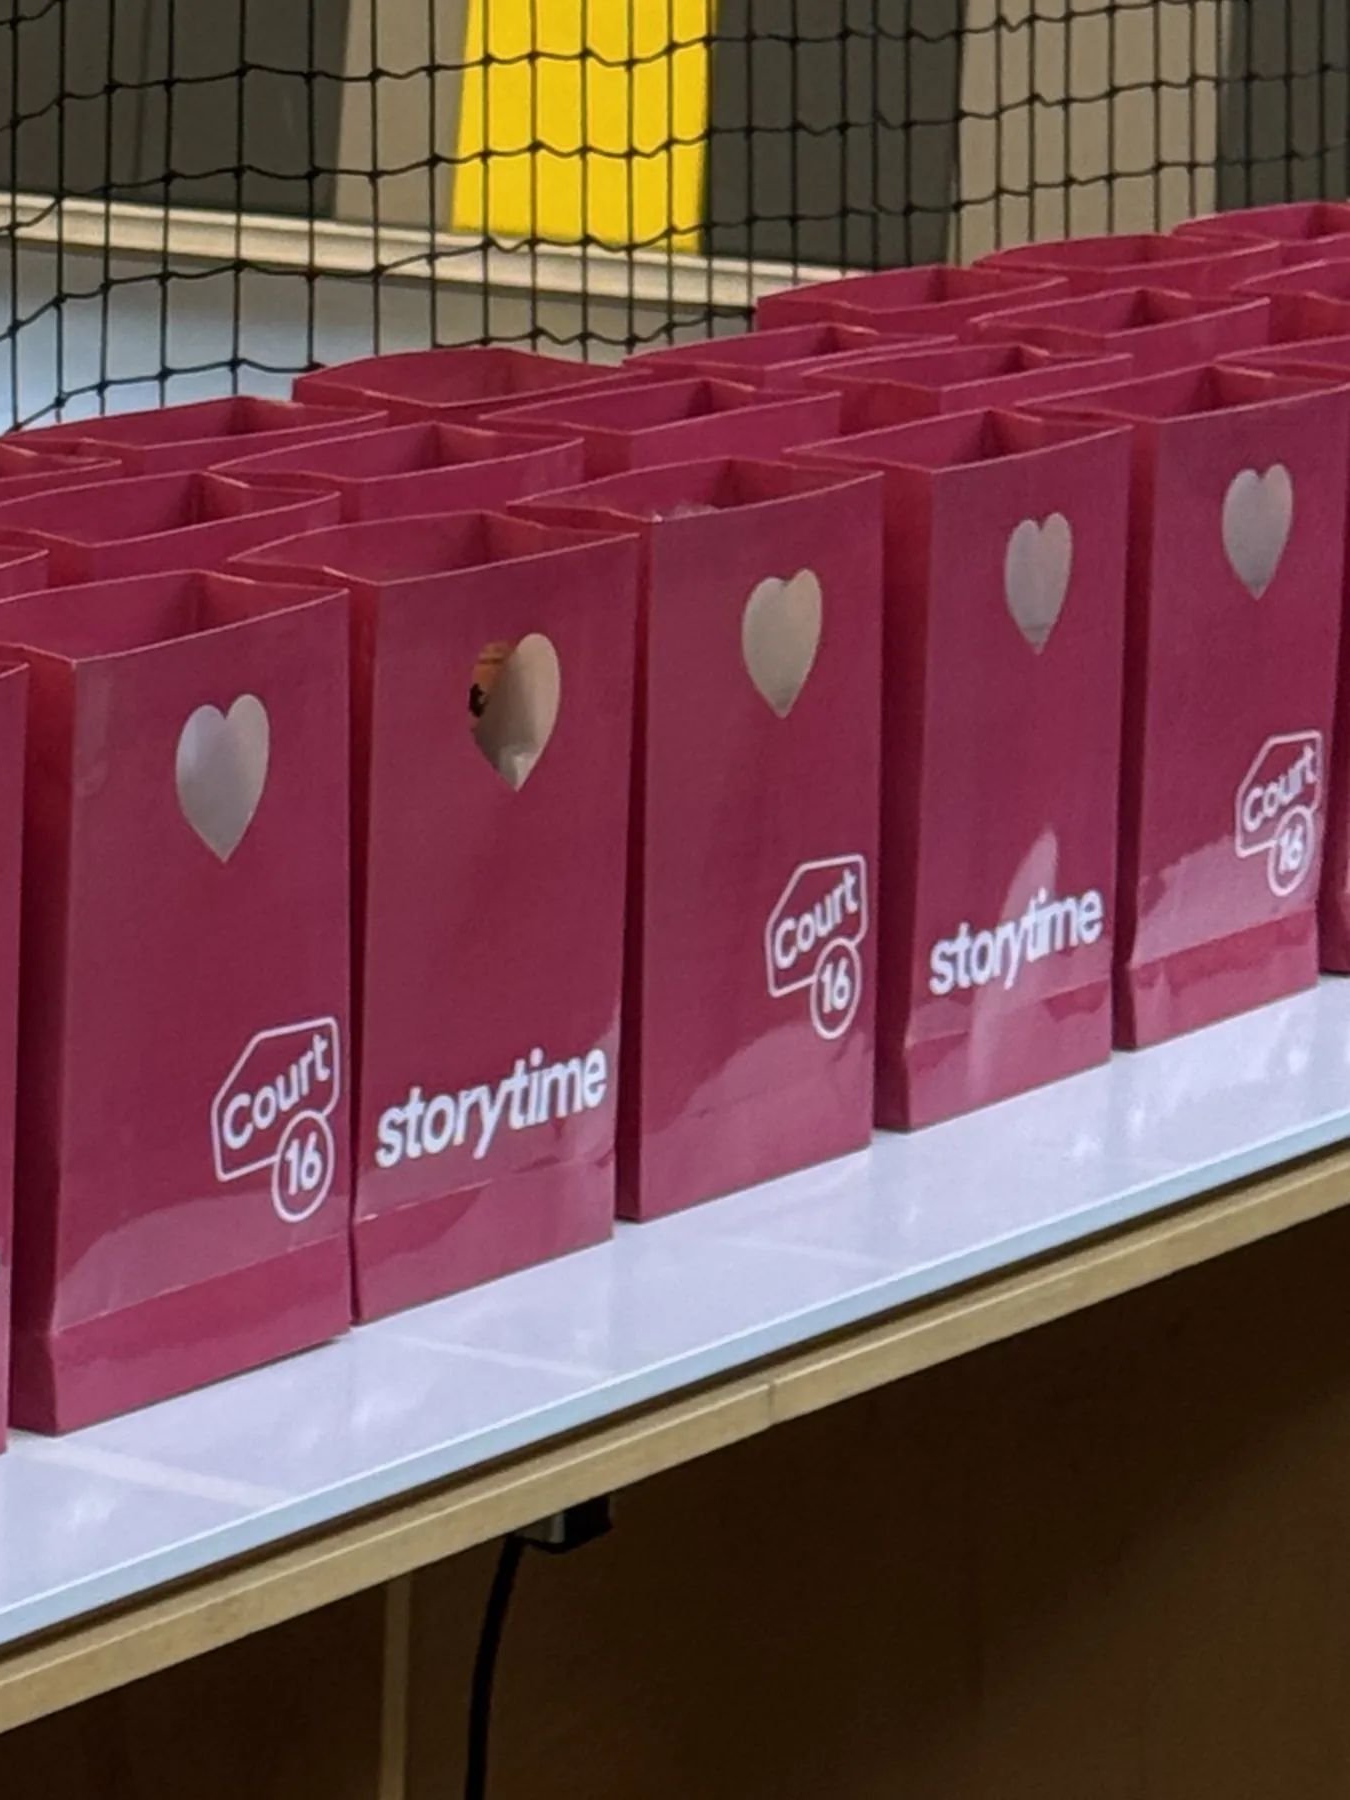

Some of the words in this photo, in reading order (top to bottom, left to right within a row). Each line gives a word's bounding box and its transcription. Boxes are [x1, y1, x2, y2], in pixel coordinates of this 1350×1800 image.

[1278, 824, 1305, 874] 16
[930, 888, 1105, 996] storytime
[820, 960, 852, 1014] 16
[375, 1047, 608, 1168] storytime
[284, 1133, 323, 1196] 16
